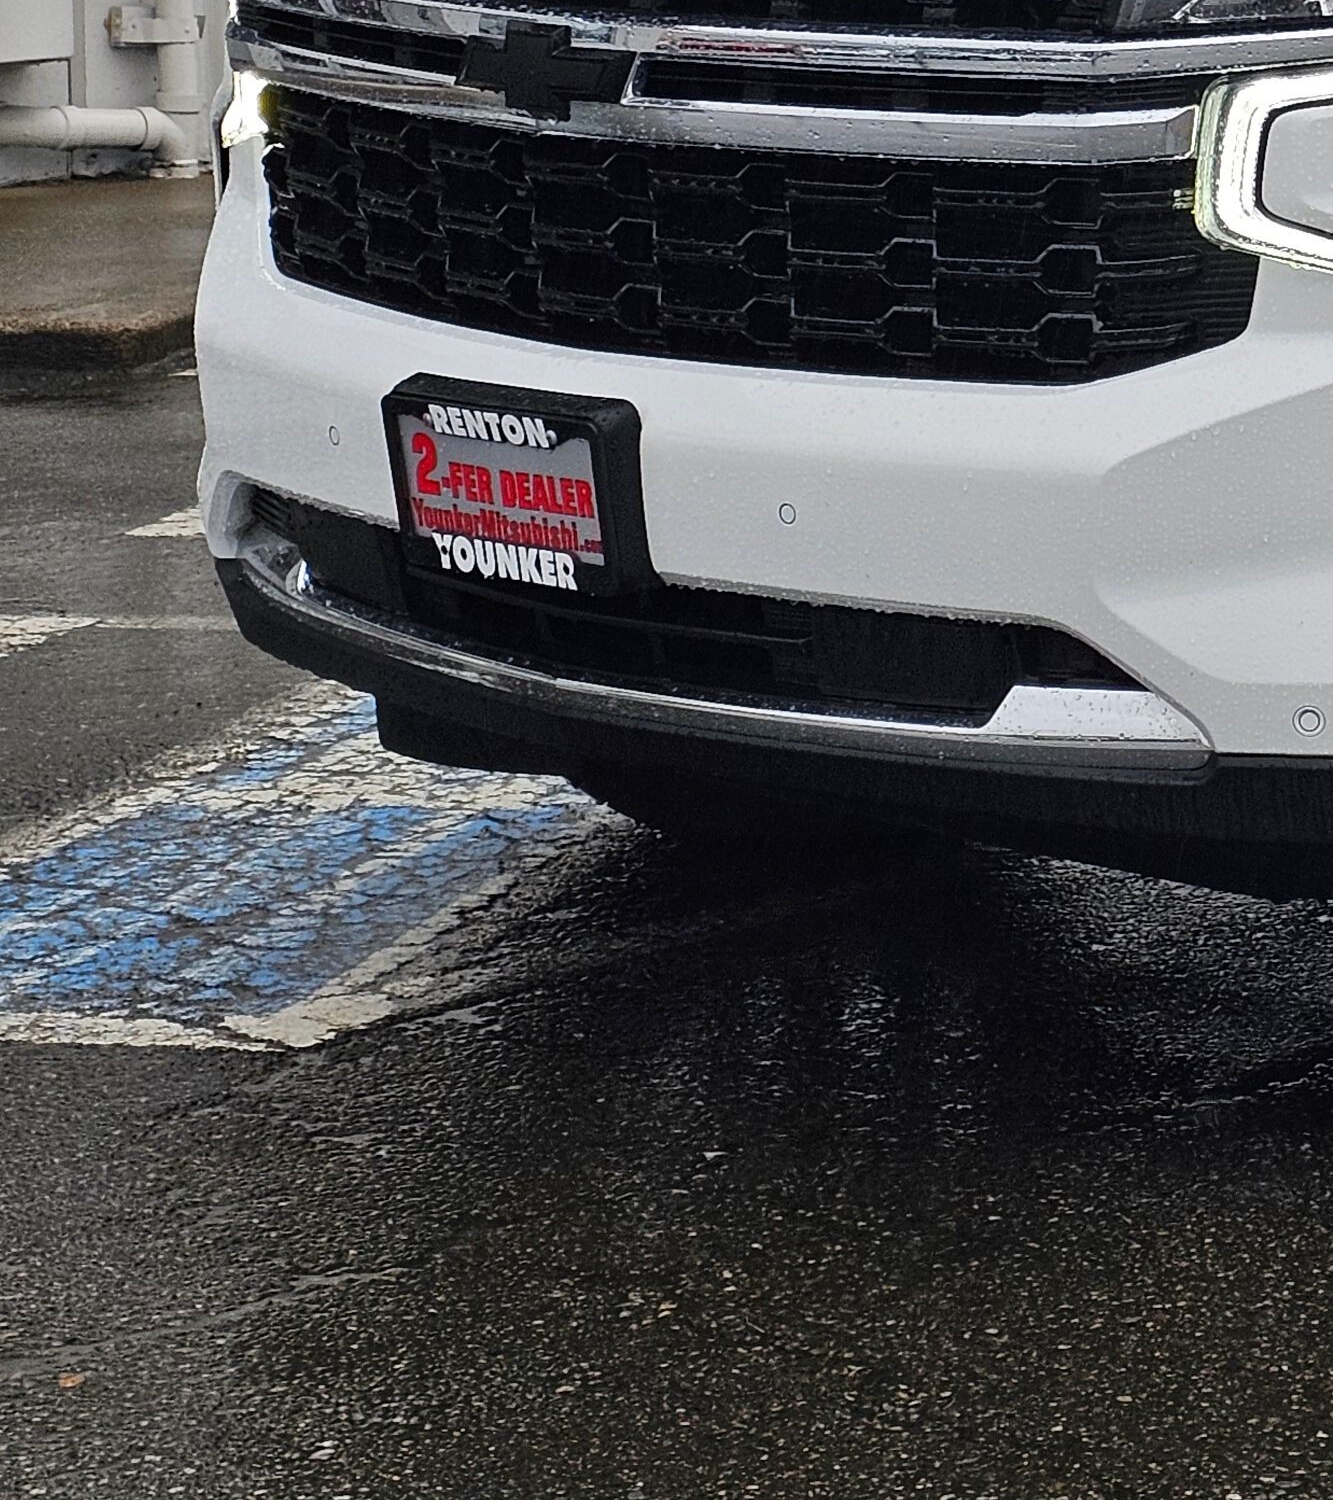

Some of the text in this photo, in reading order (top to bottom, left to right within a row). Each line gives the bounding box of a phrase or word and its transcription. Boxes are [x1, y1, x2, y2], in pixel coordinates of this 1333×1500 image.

[427, 403, 550, 449] RENTON
[411, 432, 595, 519] 2-FER DEALER
[431, 531, 579, 592] YOUNKER
